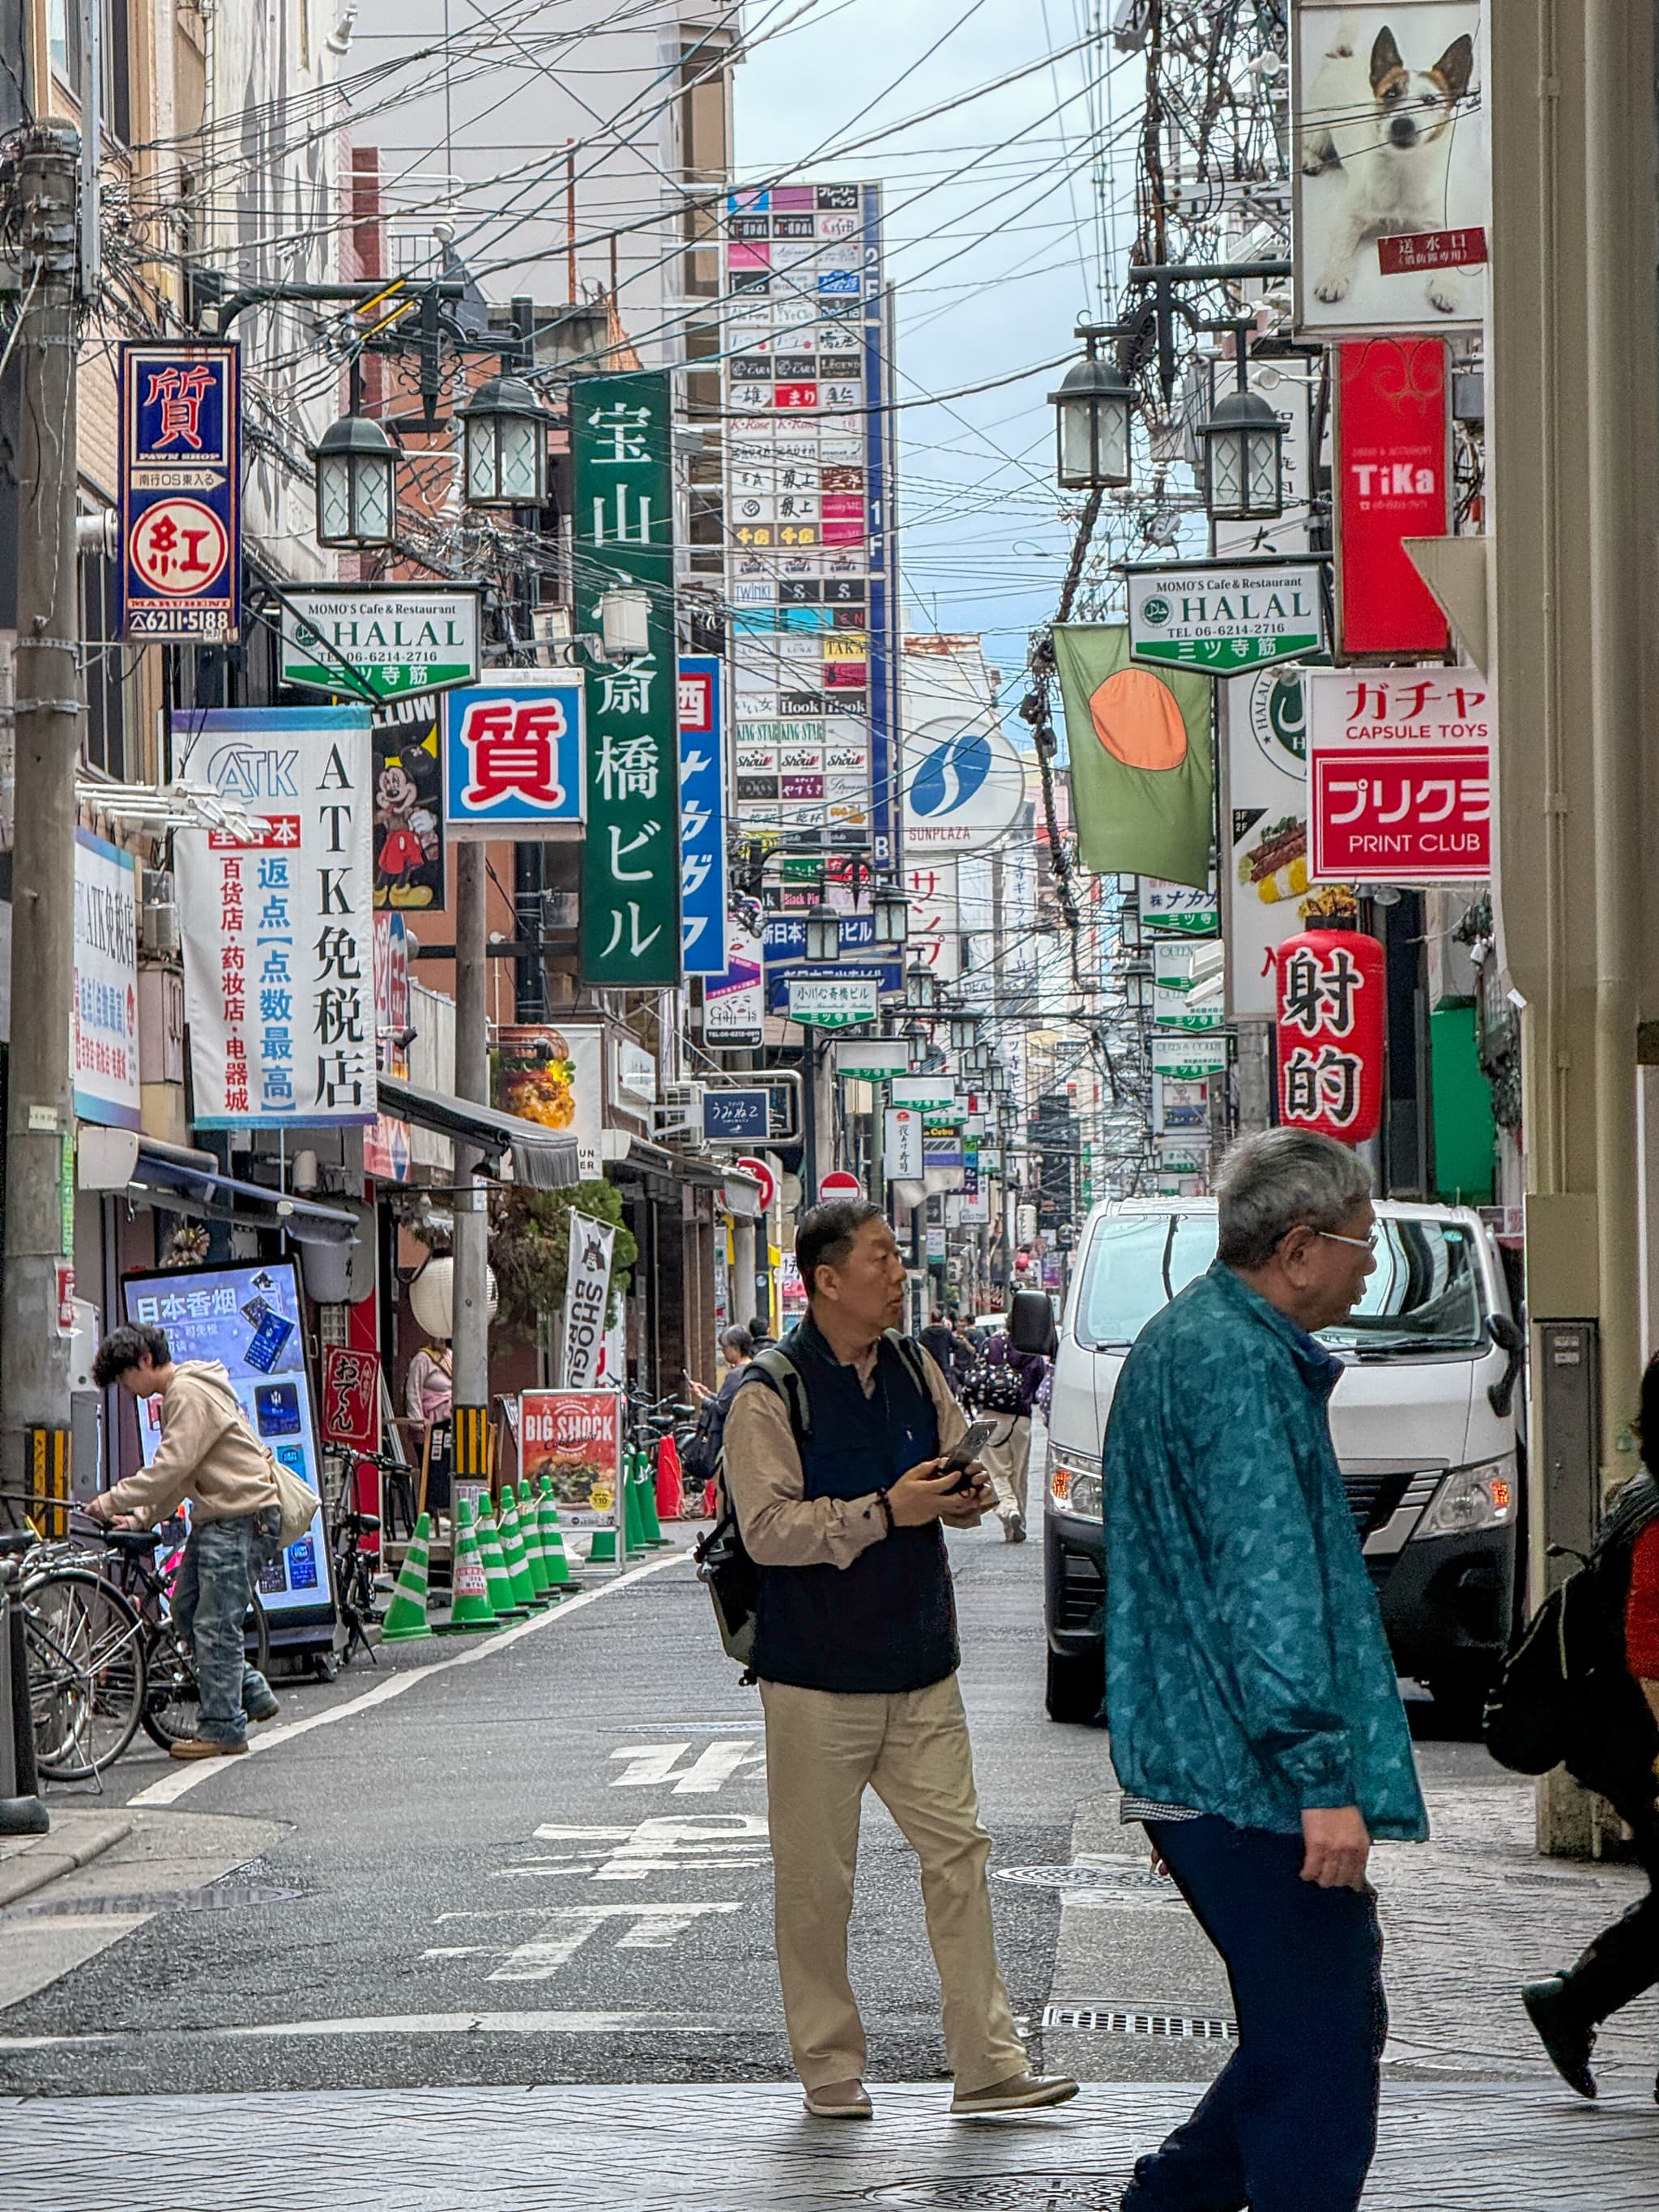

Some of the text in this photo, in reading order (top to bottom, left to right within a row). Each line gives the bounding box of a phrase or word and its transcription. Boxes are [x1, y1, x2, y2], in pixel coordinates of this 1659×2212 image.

[143, 365, 216, 449] 質
[1351, 463, 1435, 495] TiKa
[148, 514, 211, 577] 紅
[1208, 579, 1230, 590] Cafe
[1242, 578, 1302, 590] Restaurant
[131, 599, 228, 607] MARUBENI
[360, 603, 382, 615] Cafe
[396, 605, 455, 615] Restaurant
[1180, 592, 1311, 622] HALAL
[333, 620, 465, 646] HALAL
[1167, 623, 1285, 638] TEL 06-6214-2716
[318, 651, 437, 662] TE 06-6214-2716
[1178, 637, 1277, 659] 三ツ寺筋
[588, 402, 662, 958] 宝山斎橋ビル
[782, 701, 819, 714] Hook
[1346, 724, 1488, 739] CAPSULE TOYS
[464, 702, 564, 807] 質
[909, 826, 970, 841] SUNPLAZA
[1349, 833, 1481, 853] PRINT CLUB
[313, 742, 365, 1108] ATK免税店
[1282, 948, 1363, 1124] 射的
[137, 1288, 237, 1323] 日本香烟
[331, 1356, 360, 1433] おでん
[525, 1414, 553, 1442] BIG
[557, 1415, 613, 1441] SHOCK
